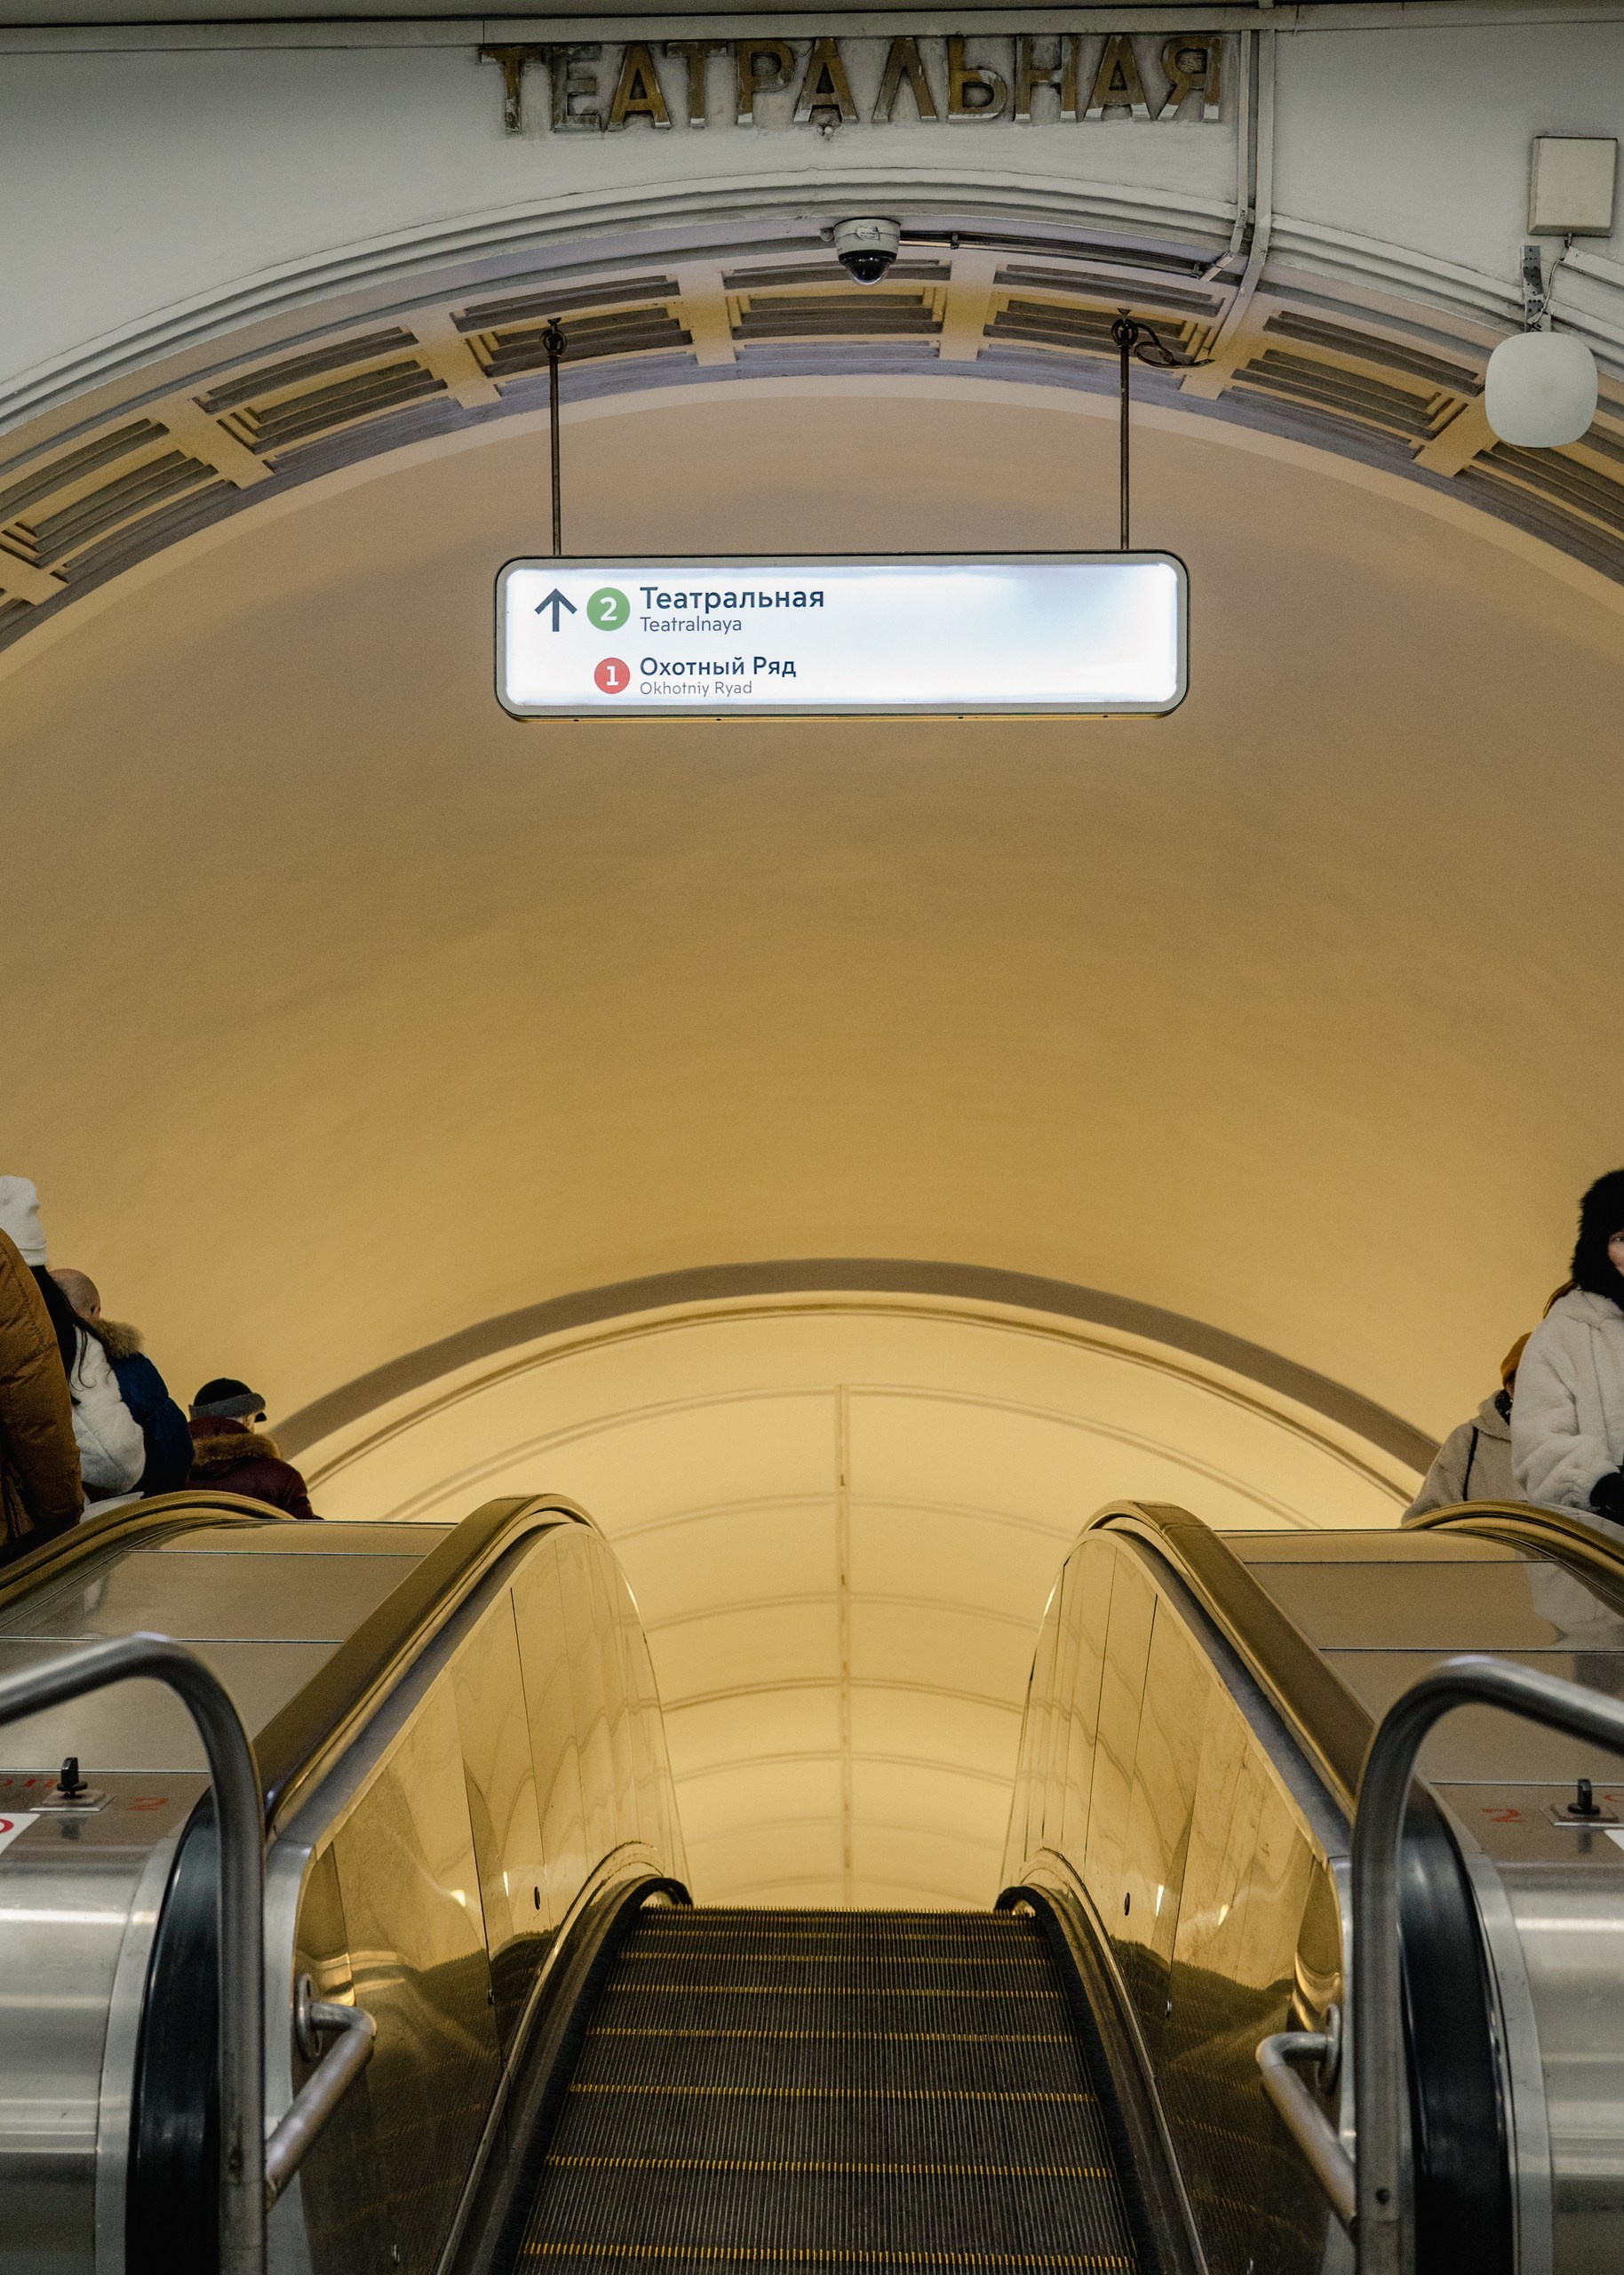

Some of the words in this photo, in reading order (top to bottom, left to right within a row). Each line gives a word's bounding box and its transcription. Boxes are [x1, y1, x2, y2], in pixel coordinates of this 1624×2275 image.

[479, 36, 1222, 134] ТЕАТРАЛЬНАЯ
[599, 596, 618, 621] 2
[639, 586, 824, 614] Театральная
[639, 616, 742, 635] Teatralnaya
[606, 666, 620, 686] 1
[640, 656, 744, 676] Охотный
[753, 656, 797, 678] Ряд
[640, 681, 710, 698] Okhotniy
[715, 680, 752, 698] Ryad
